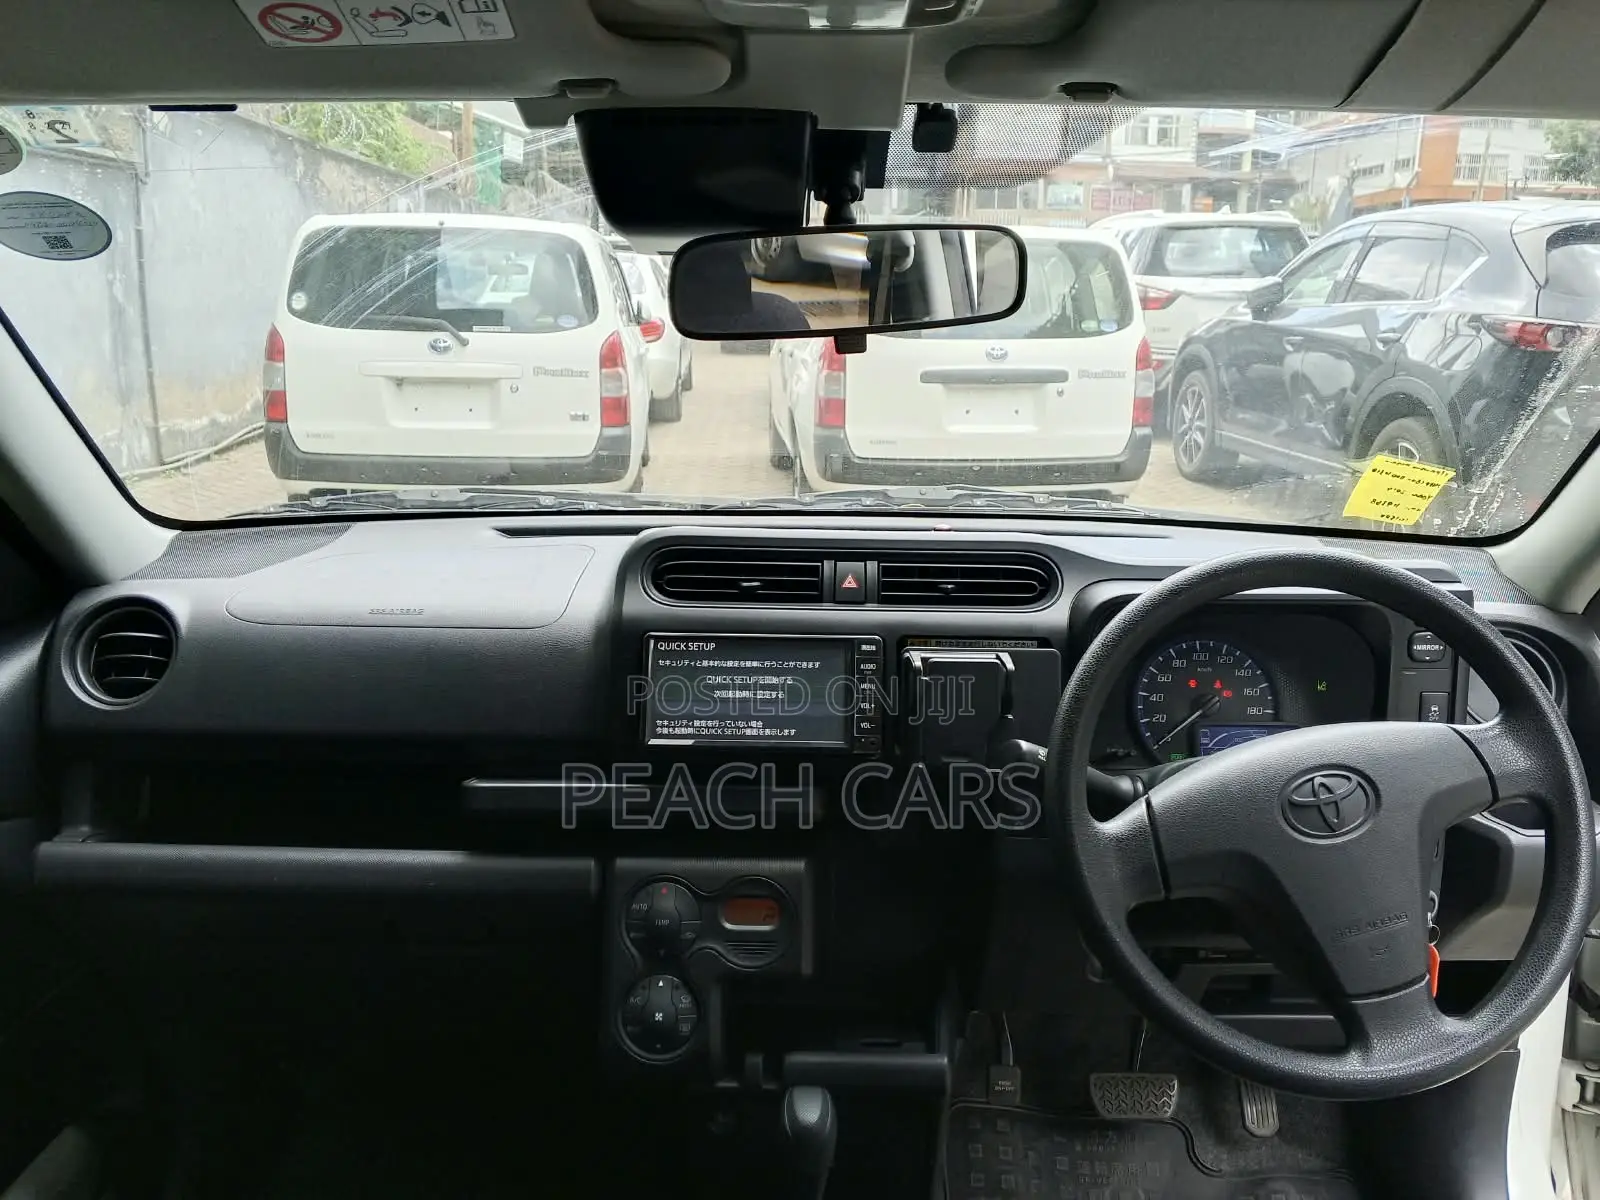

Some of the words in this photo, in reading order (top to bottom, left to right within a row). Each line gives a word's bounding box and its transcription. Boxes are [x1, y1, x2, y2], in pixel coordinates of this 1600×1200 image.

[658, 642, 687, 651] QUICK
[688, 642, 716, 651] SETUP
[1192, 652, 1209, 661] 100
[1217, 655, 1234, 664] 120
[1172, 659, 1187, 668] 80
[1157, 673, 1172, 682] 60
[1235, 669, 1252, 677] 140
[706, 675, 732, 684] QUICK
[1243, 688, 1260, 696] 160
[1149, 693, 1164, 702] 40
[1247, 706, 1263, 715] 180
[1152, 714, 1167, 723] 20
[632, 903, 648, 911] AUTO
